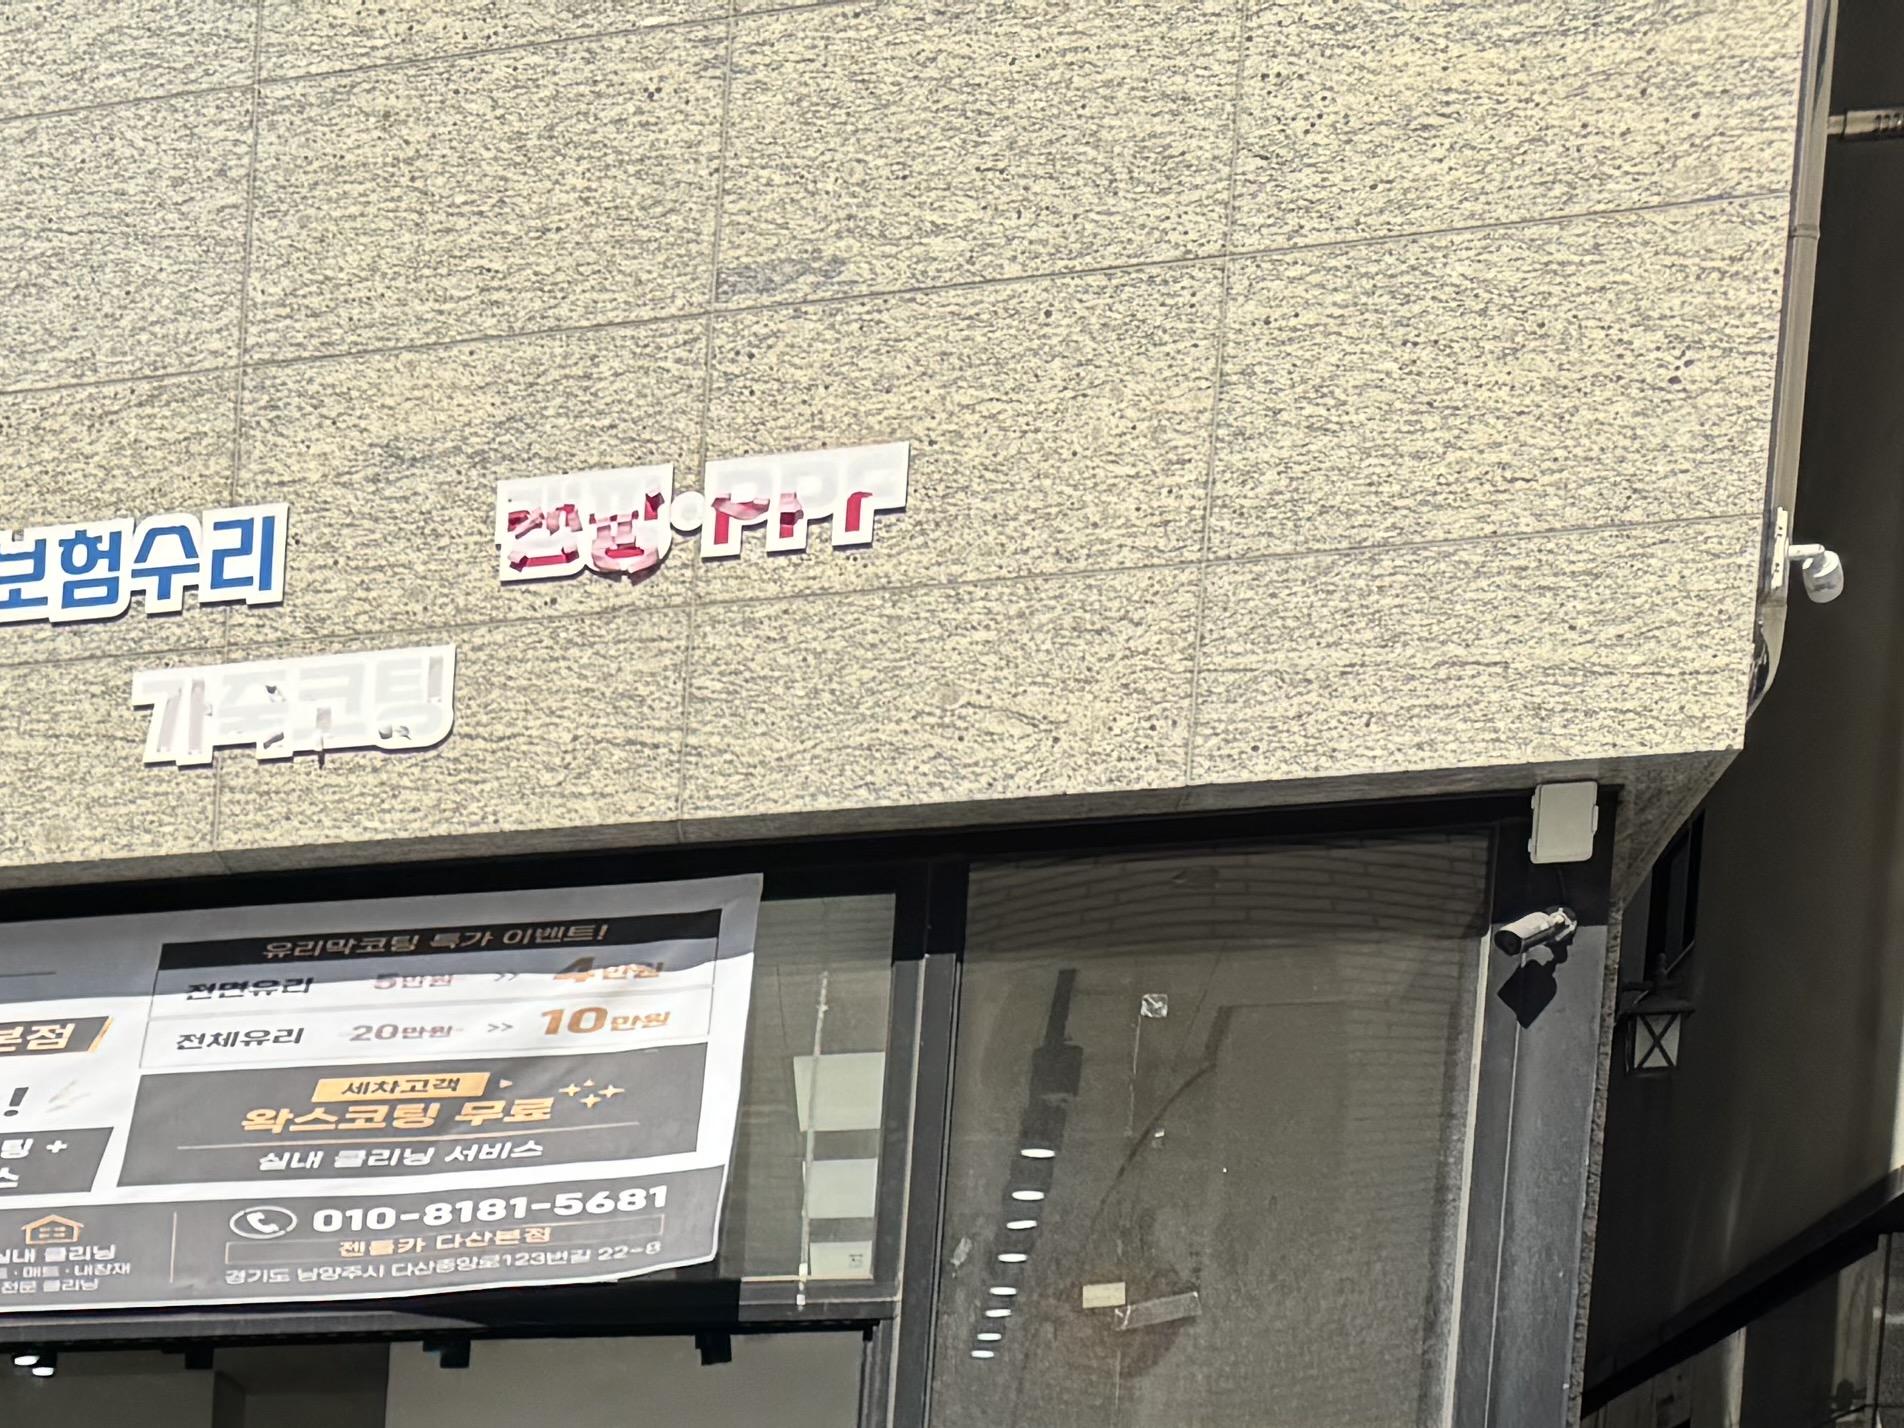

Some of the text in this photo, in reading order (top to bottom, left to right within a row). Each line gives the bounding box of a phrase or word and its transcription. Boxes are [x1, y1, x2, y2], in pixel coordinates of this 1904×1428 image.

[262, 922, 610, 960] 유리막코팅 특가 이벤트!
[185, 973, 315, 1002] 전면유리
[174, 1025, 305, 1052] 전체유리
[340, 1075, 464, 1098] 세차고객
[240, 1096, 555, 1136] 왁스코팅 무료
[257, 1138, 544, 1172] 실내 클리닝 서비스
[311, 1184, 669, 1233] 010-8181-5681
[338, 1226, 553, 1259] 젠틀카 다산본점
[225, 1266, 291, 1286] 경기도
[297, 1261, 387, 1284] 남양주시
